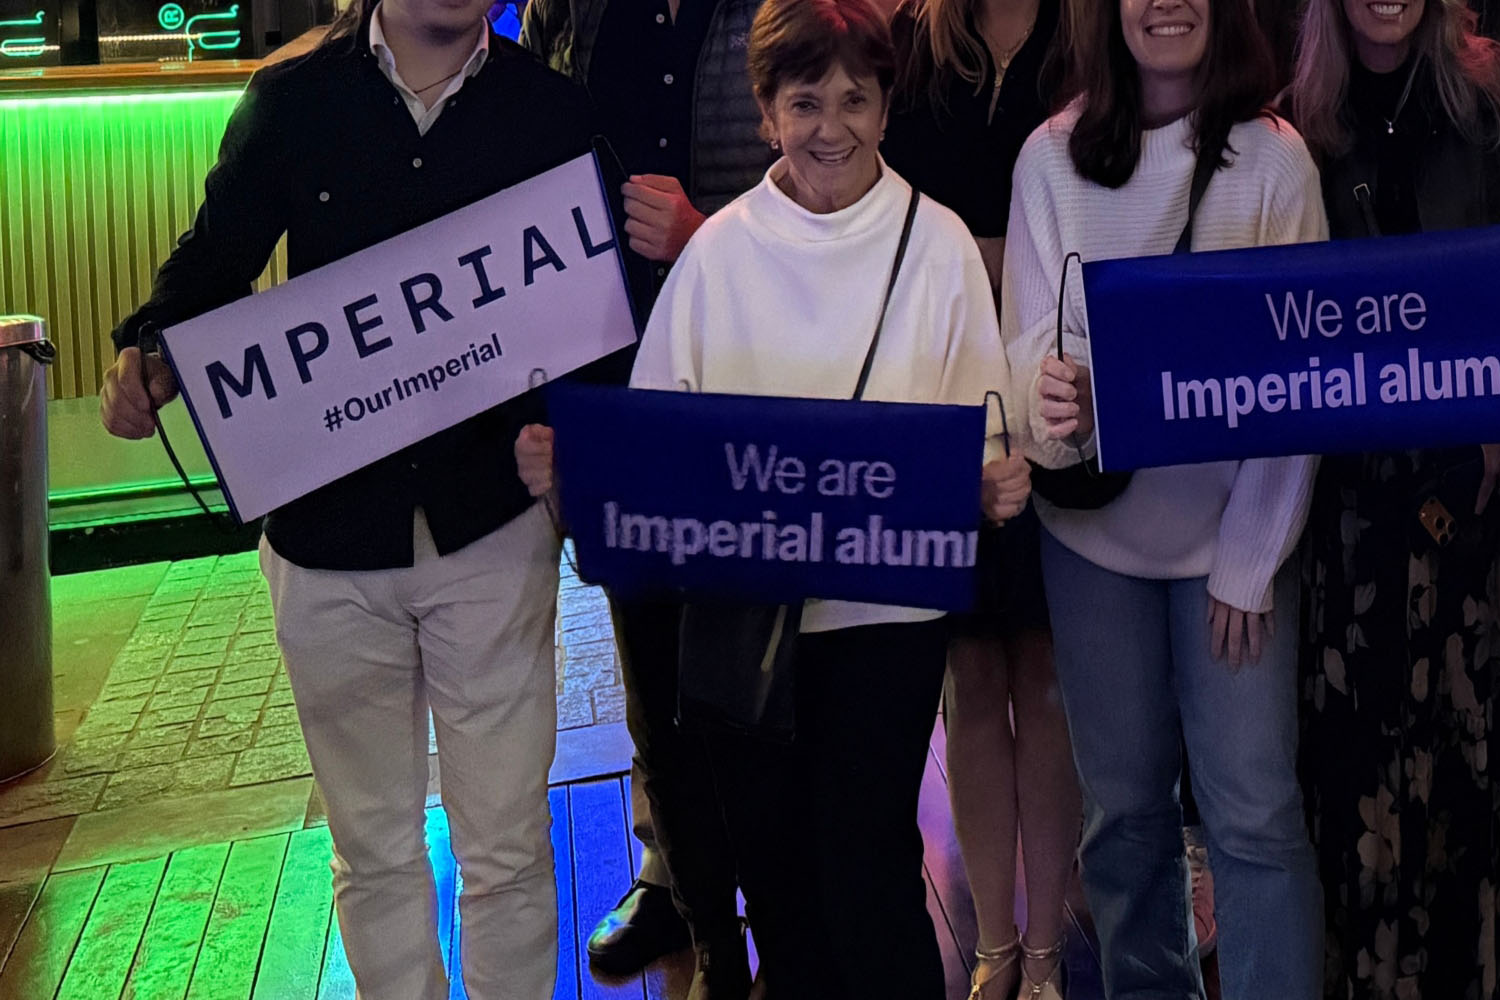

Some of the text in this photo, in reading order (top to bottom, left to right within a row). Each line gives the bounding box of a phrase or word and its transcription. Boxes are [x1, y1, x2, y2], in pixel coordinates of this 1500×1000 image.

[1266, 290, 1426, 341] We are
[323, 333, 503, 433] #OurImperial
[1161, 352, 1365, 428] Imperial
[725, 442, 896, 498] We are
[603, 501, 823, 565] Imperial
